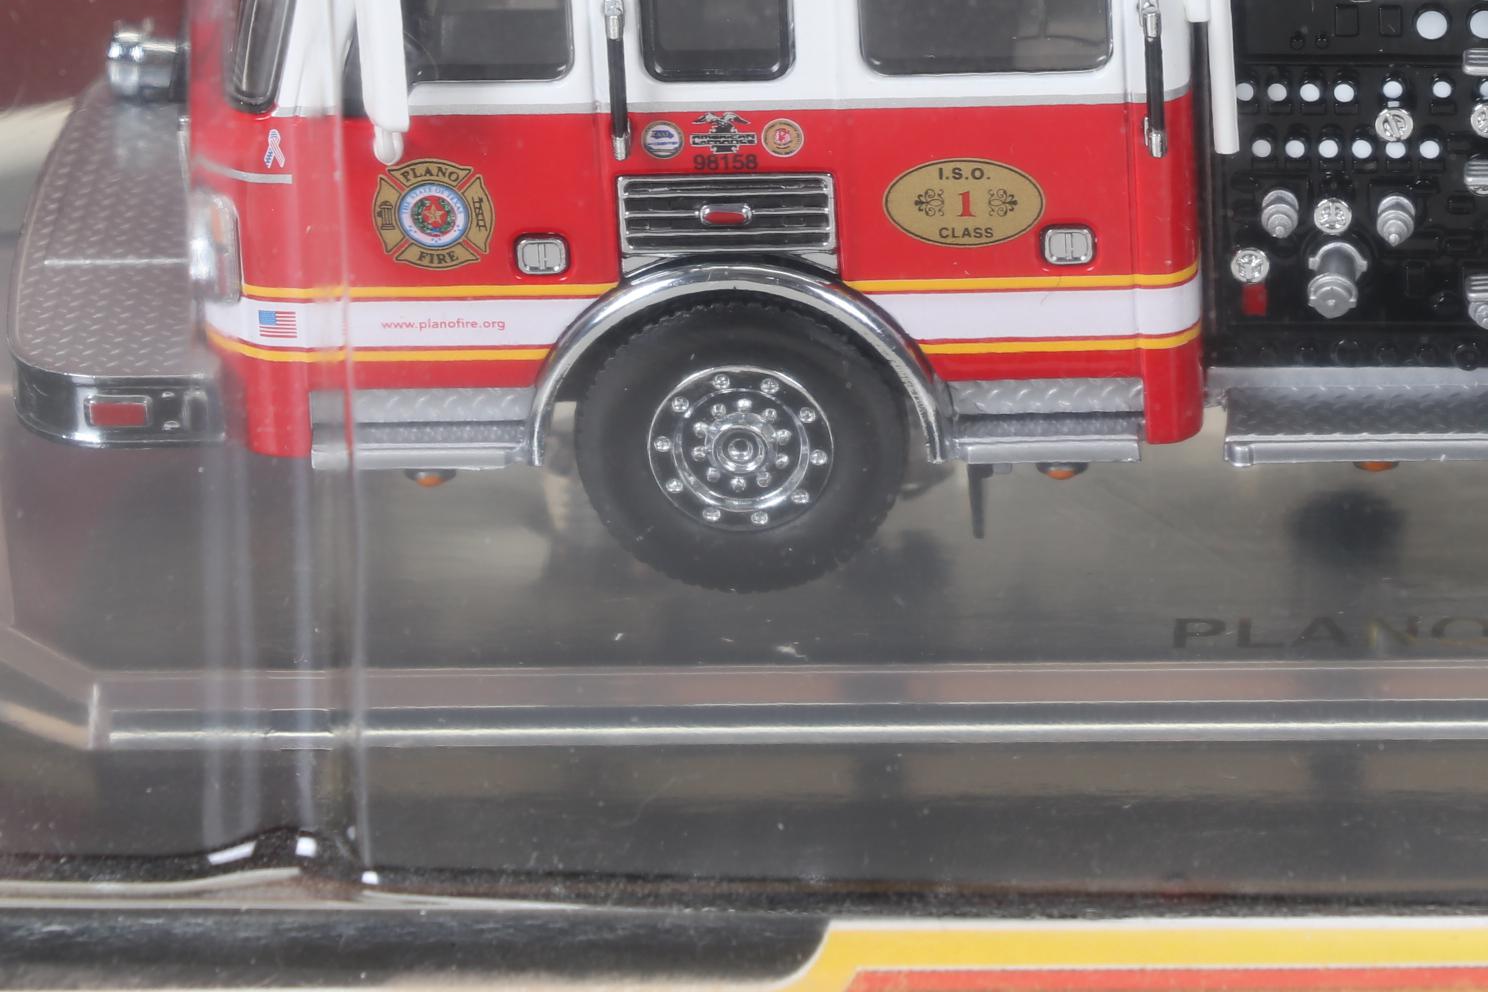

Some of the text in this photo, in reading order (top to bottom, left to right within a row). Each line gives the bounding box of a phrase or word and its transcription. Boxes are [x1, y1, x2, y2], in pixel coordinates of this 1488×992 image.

[692, 153, 758, 170] 98158
[399, 166, 460, 183] PLANO
[938, 167, 991, 181] I.S.O.
[957, 190, 977, 217] 1
[938, 227, 994, 239] CLASS
[418, 251, 459, 265] FIRE
[380, 318, 506, 331] www.planofire.org
